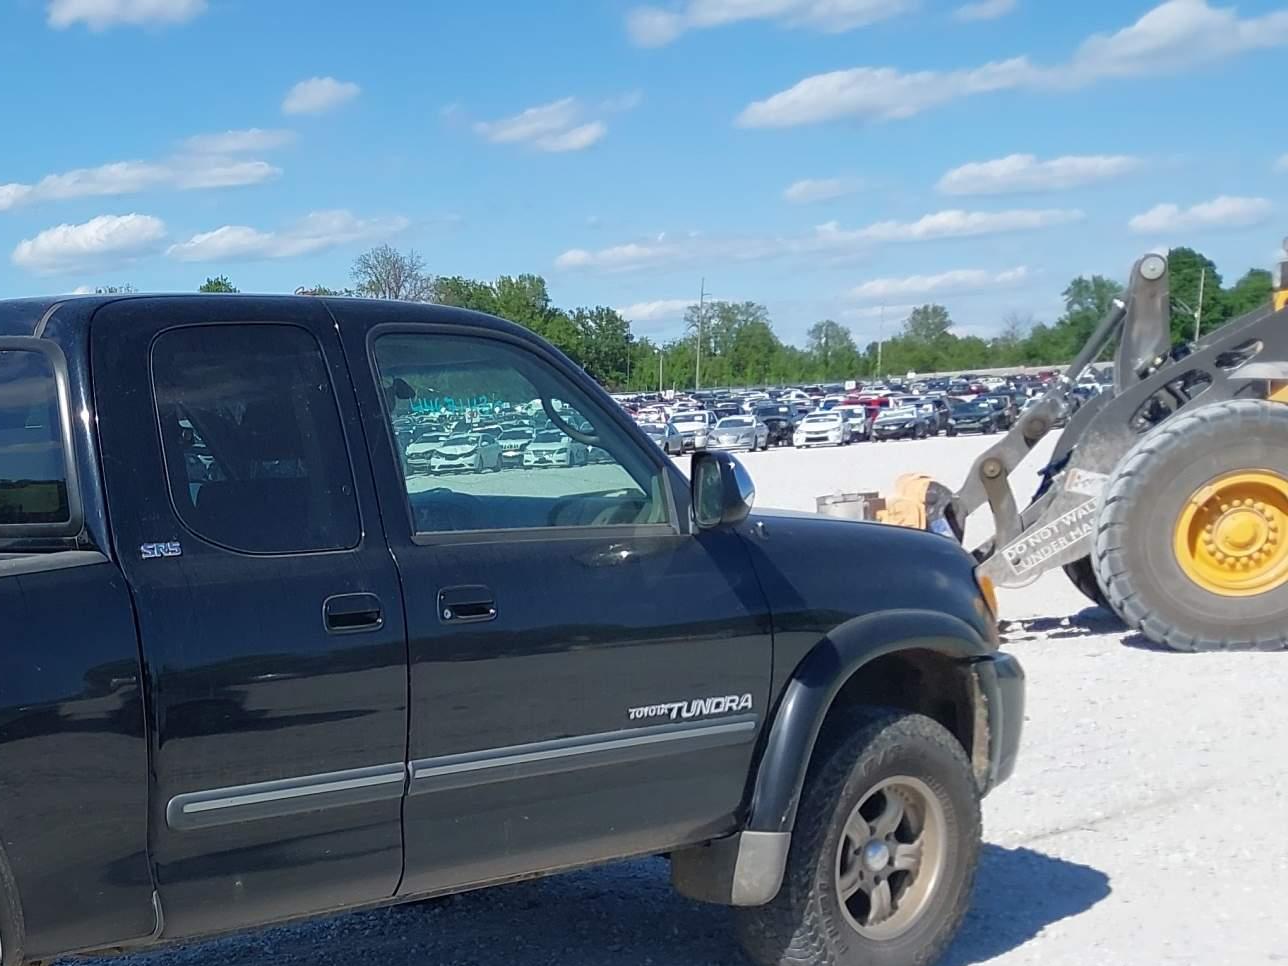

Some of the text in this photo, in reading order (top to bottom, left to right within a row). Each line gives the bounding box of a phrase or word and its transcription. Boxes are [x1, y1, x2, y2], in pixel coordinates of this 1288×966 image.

[1006, 500, 1096, 560] DO NOT WAL
[1022, 536, 1069, 567] UNDER
[628, 693, 753, 720] TOYOTA TUNDRA
